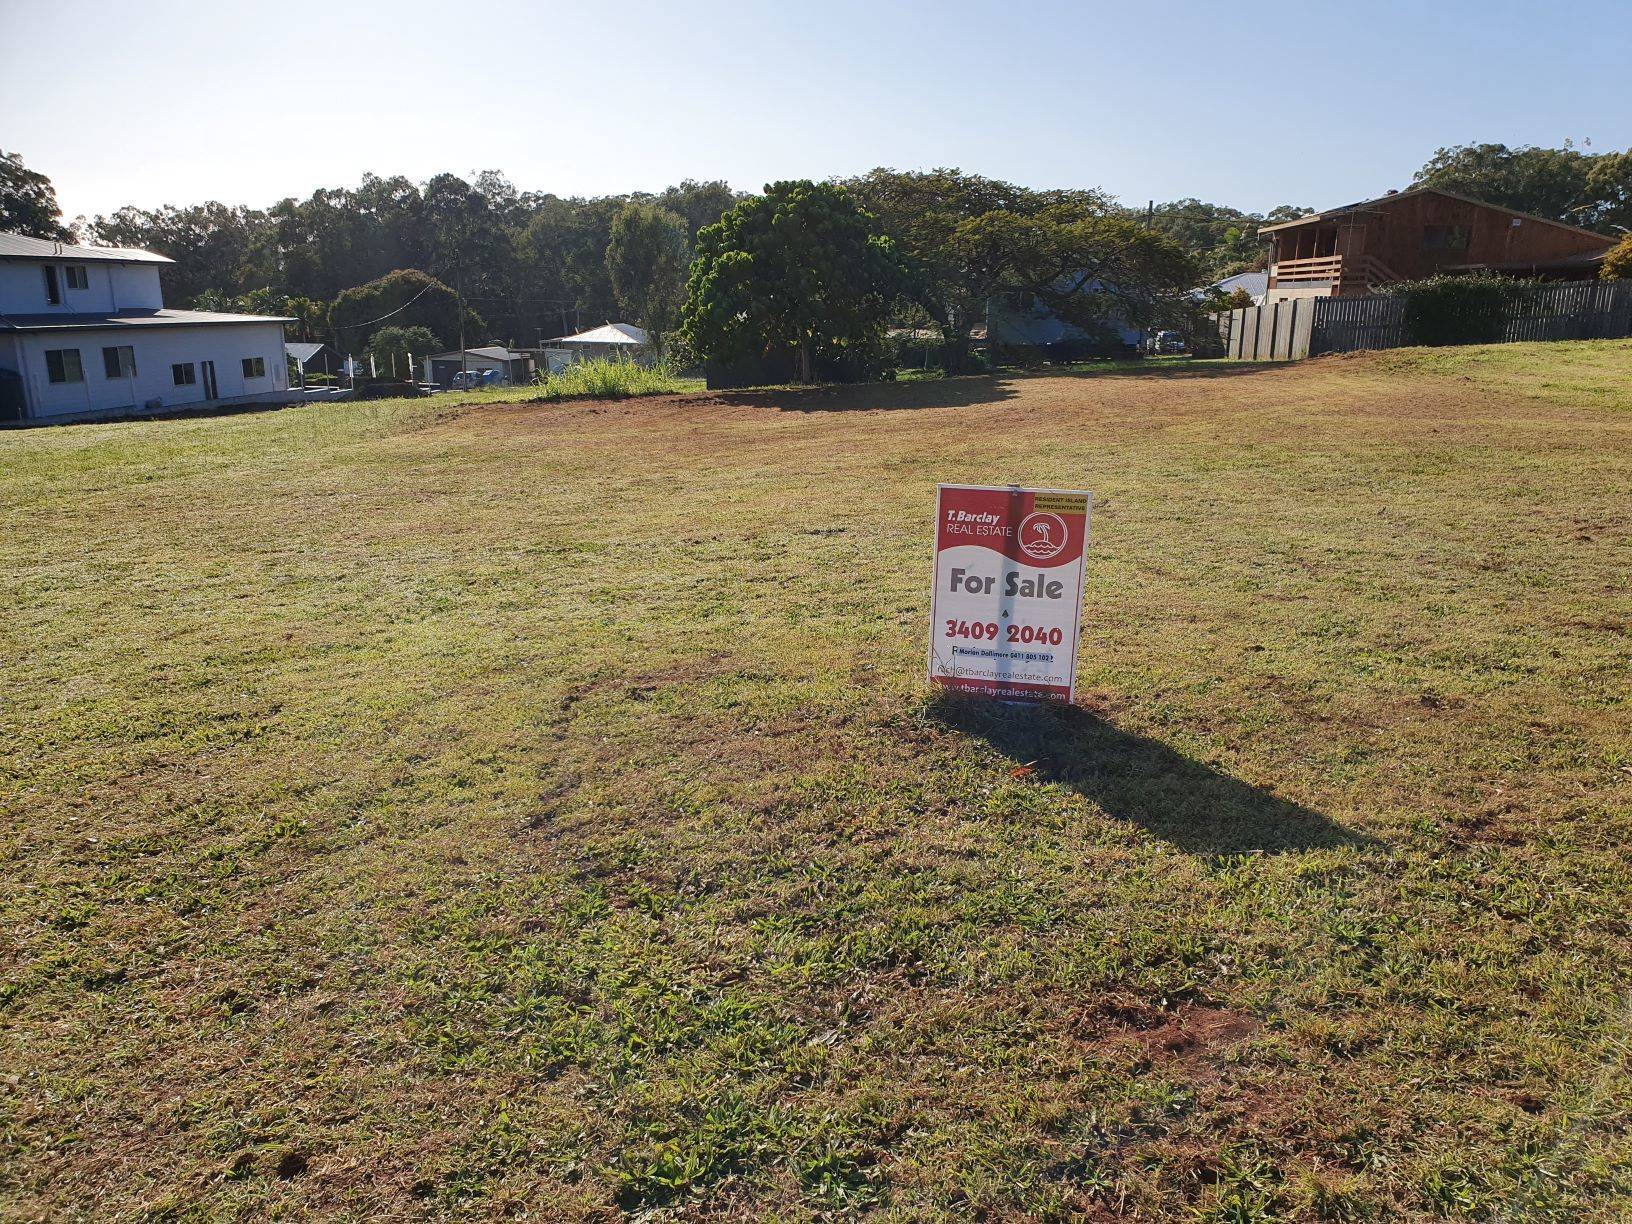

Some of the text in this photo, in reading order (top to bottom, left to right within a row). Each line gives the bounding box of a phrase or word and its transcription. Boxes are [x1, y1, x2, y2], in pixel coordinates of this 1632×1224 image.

[1034, 503, 1086, 511] REPRESENTATIVE
[947, 510, 1000, 526] T.Barclay
[947, 523, 1013, 537] REAL ESTATE
[950, 567, 1064, 600] For Sale
[945, 619, 1063, 646] 3409 2040
